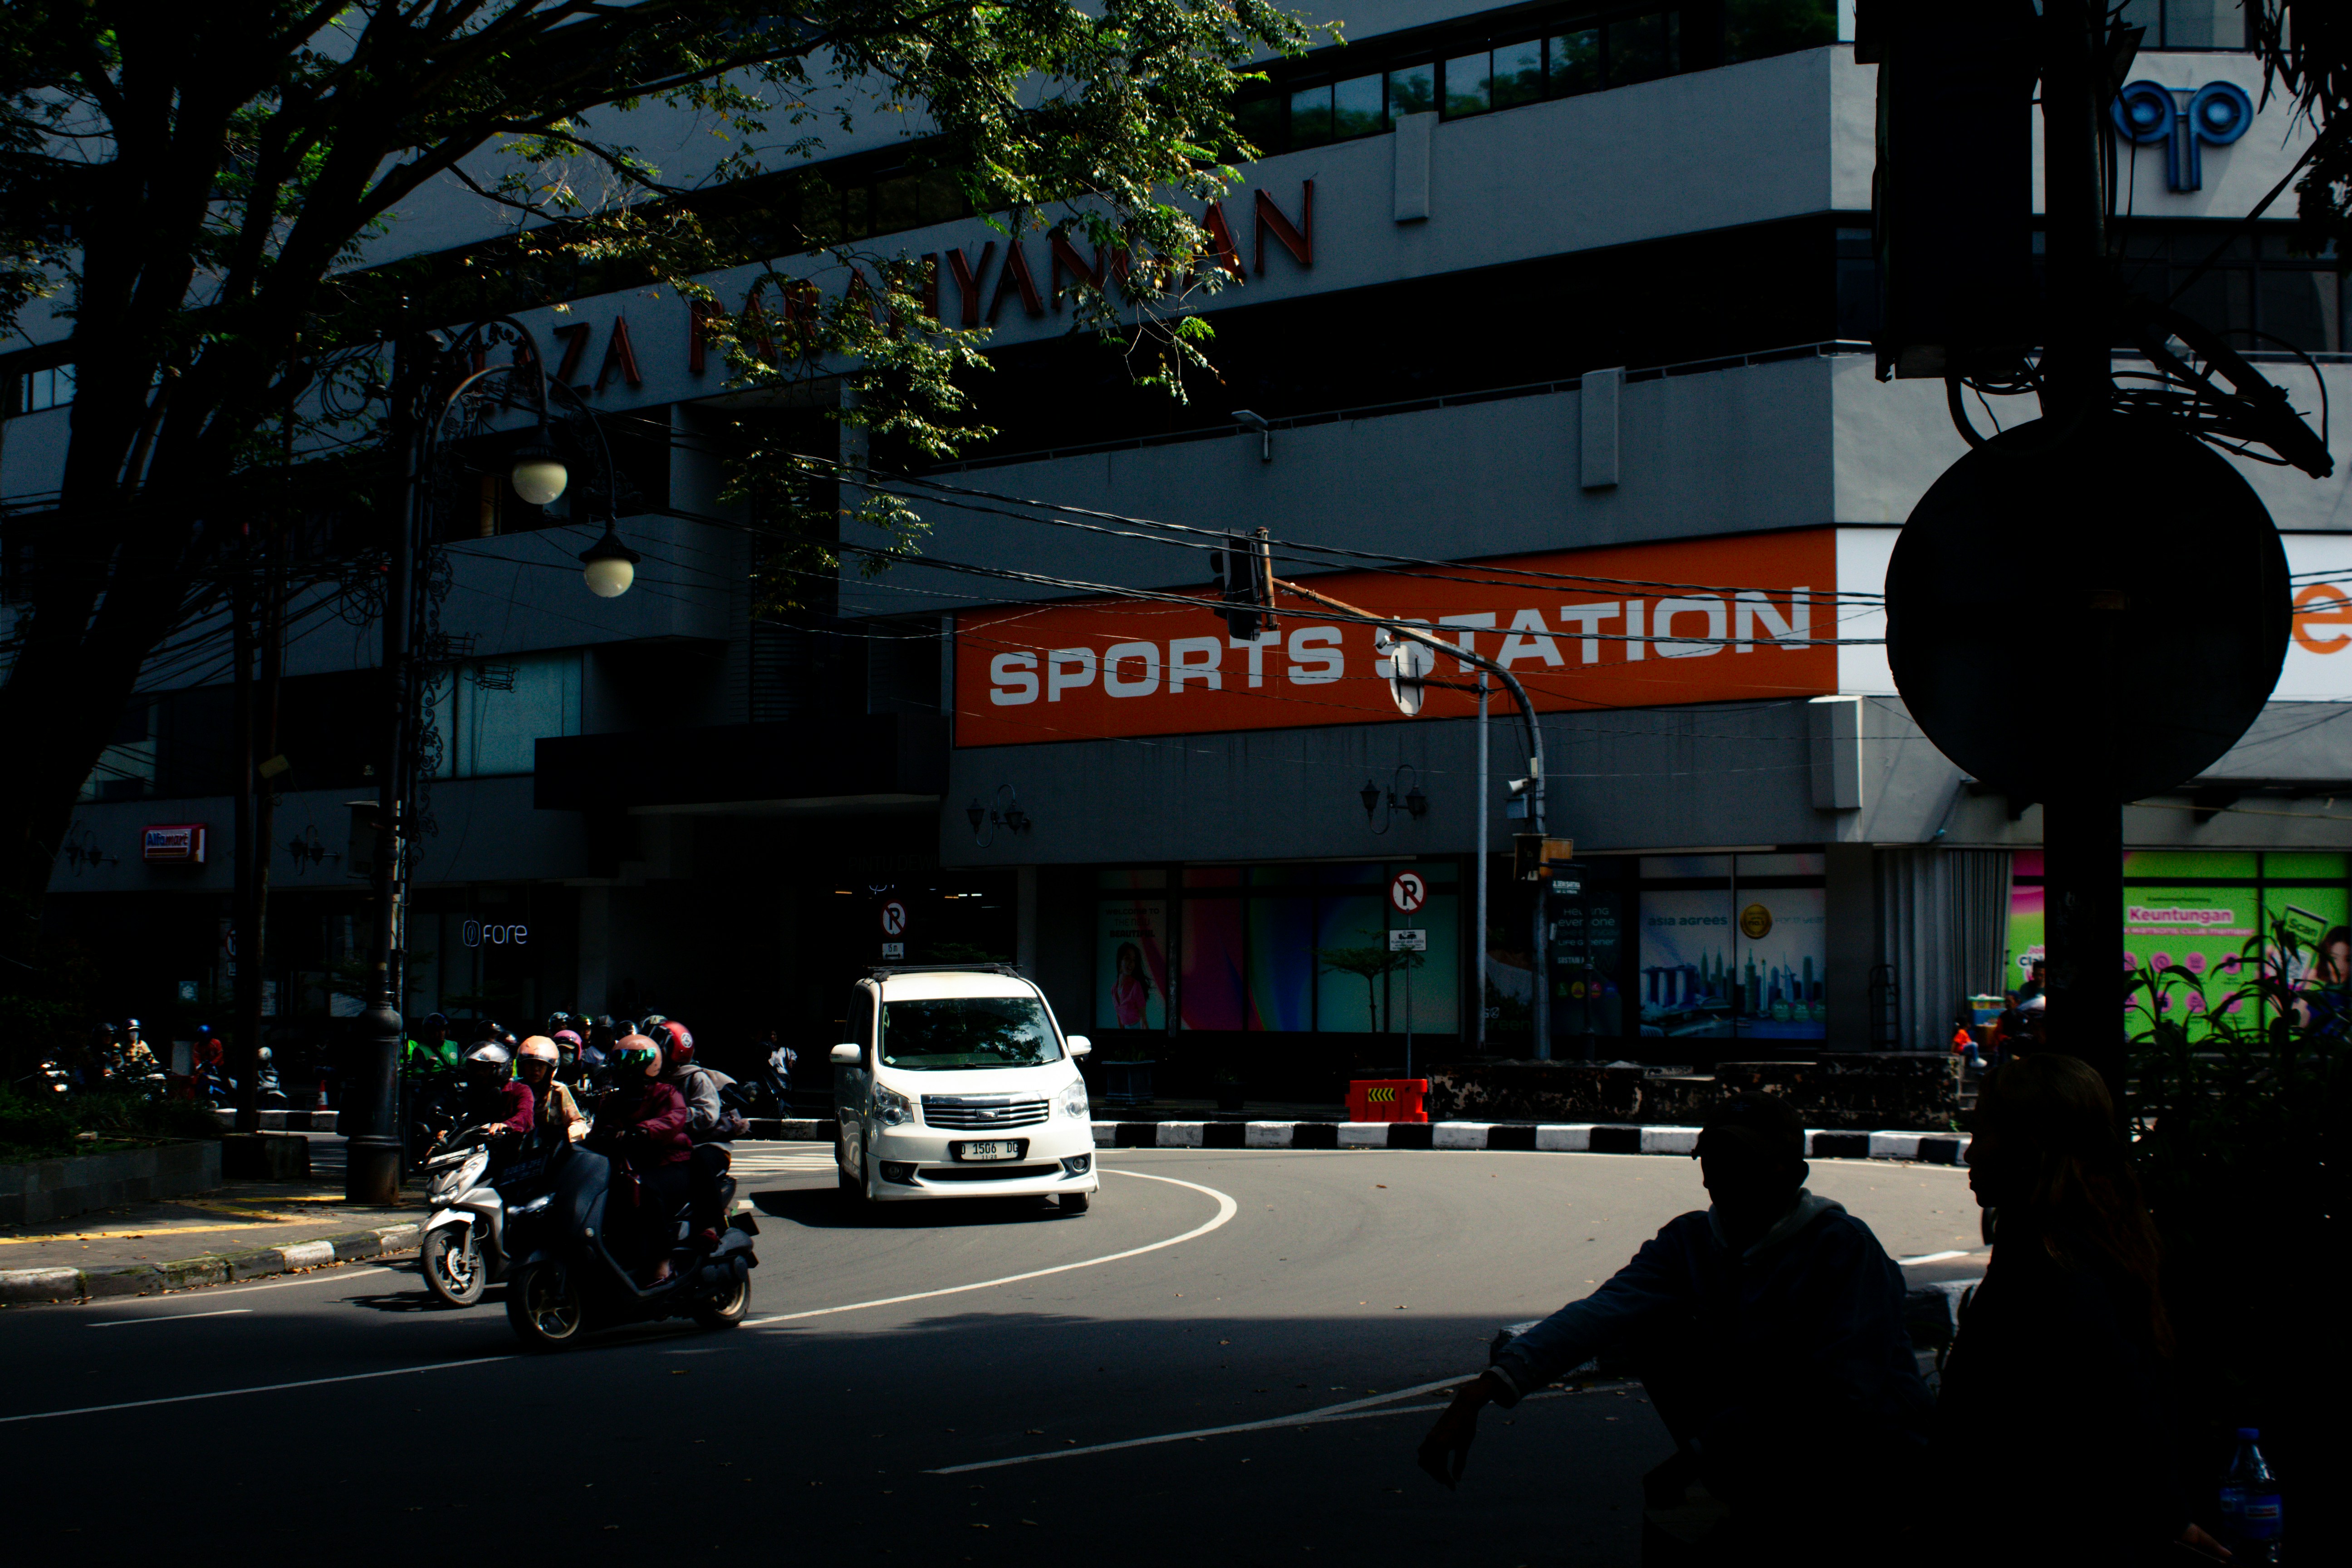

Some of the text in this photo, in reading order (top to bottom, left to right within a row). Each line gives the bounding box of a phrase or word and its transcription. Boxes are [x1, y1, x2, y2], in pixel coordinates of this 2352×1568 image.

[990, 586, 1811, 706] SPORTS STATION
[146, 832, 188, 846] Alfamart
[848, 854, 937, 872] PINTU DEWI
[1558, 918, 1616, 927] everone
[1647, 916, 1728, 926] asia agrees
[2130, 908, 2231, 924] Keuntungan
[2288, 918, 2318, 937] Scan
[961, 1144, 966, 1155] D
[973, 1142, 997, 1154] 1506
